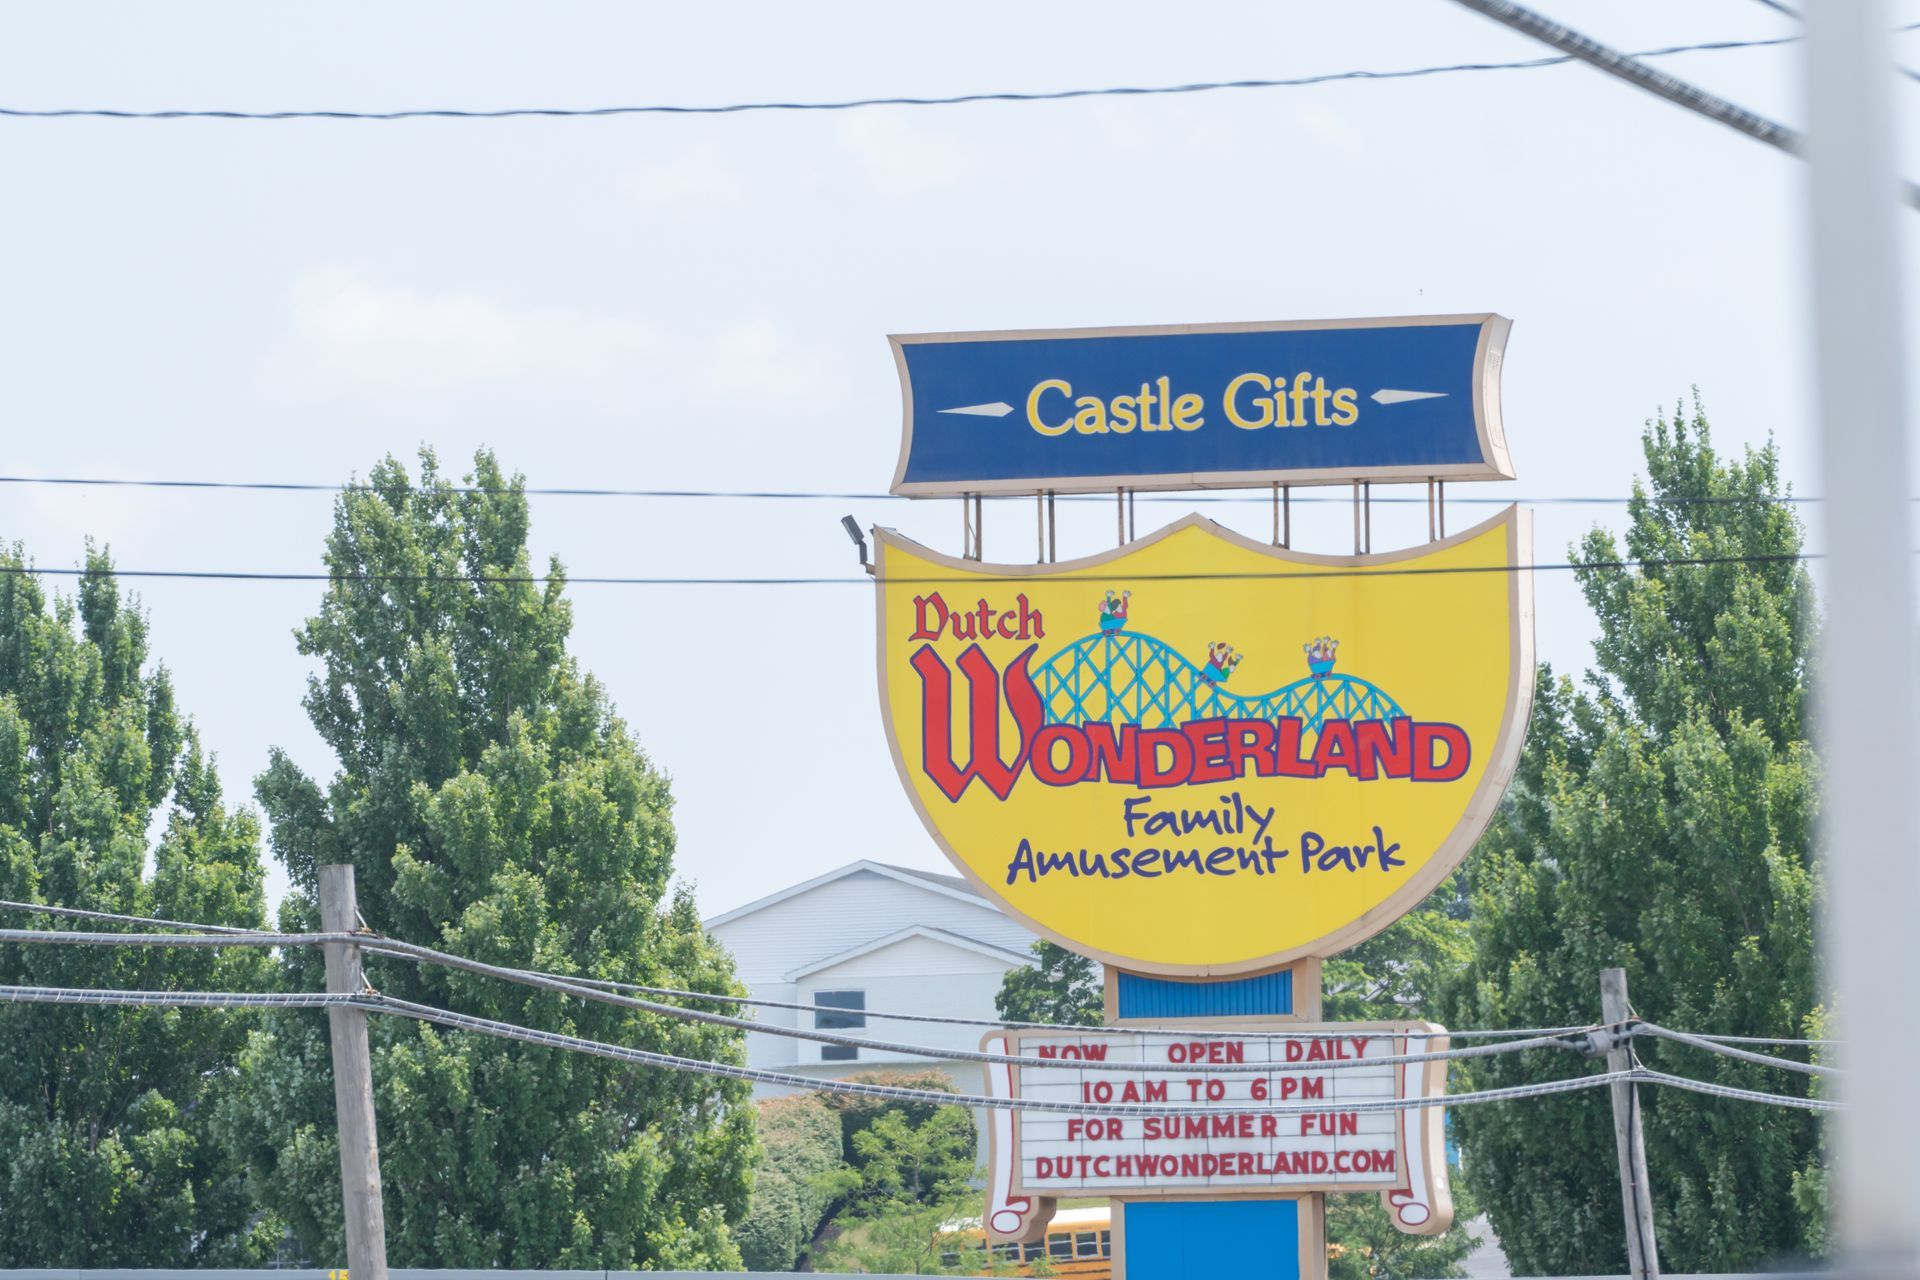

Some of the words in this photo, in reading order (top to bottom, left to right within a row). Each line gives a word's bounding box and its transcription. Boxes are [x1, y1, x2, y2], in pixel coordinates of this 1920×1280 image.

[1026, 376, 1204, 436] Castle
[1223, 371, 1359, 430] Gifts
[909, 592, 1046, 641] Dutch
[1124, 792, 1275, 844] Family
[1006, 837, 1288, 885] Amusement
[1300, 826, 1405, 873] Park
[1039, 1044, 1107, 1061] NOW
[1168, 1042, 1244, 1064] OPEN
[1286, 1038, 1368, 1062] DAILY
[1187, 1079, 1225, 1102] TO
[1068, 1118, 1123, 1141] FOR
[1144, 1115, 1277, 1140] SUMMER
[1302, 1113, 1358, 1137] FUN
[1036, 1150, 1396, 1179] DUTCHWONDERLAND.COM
